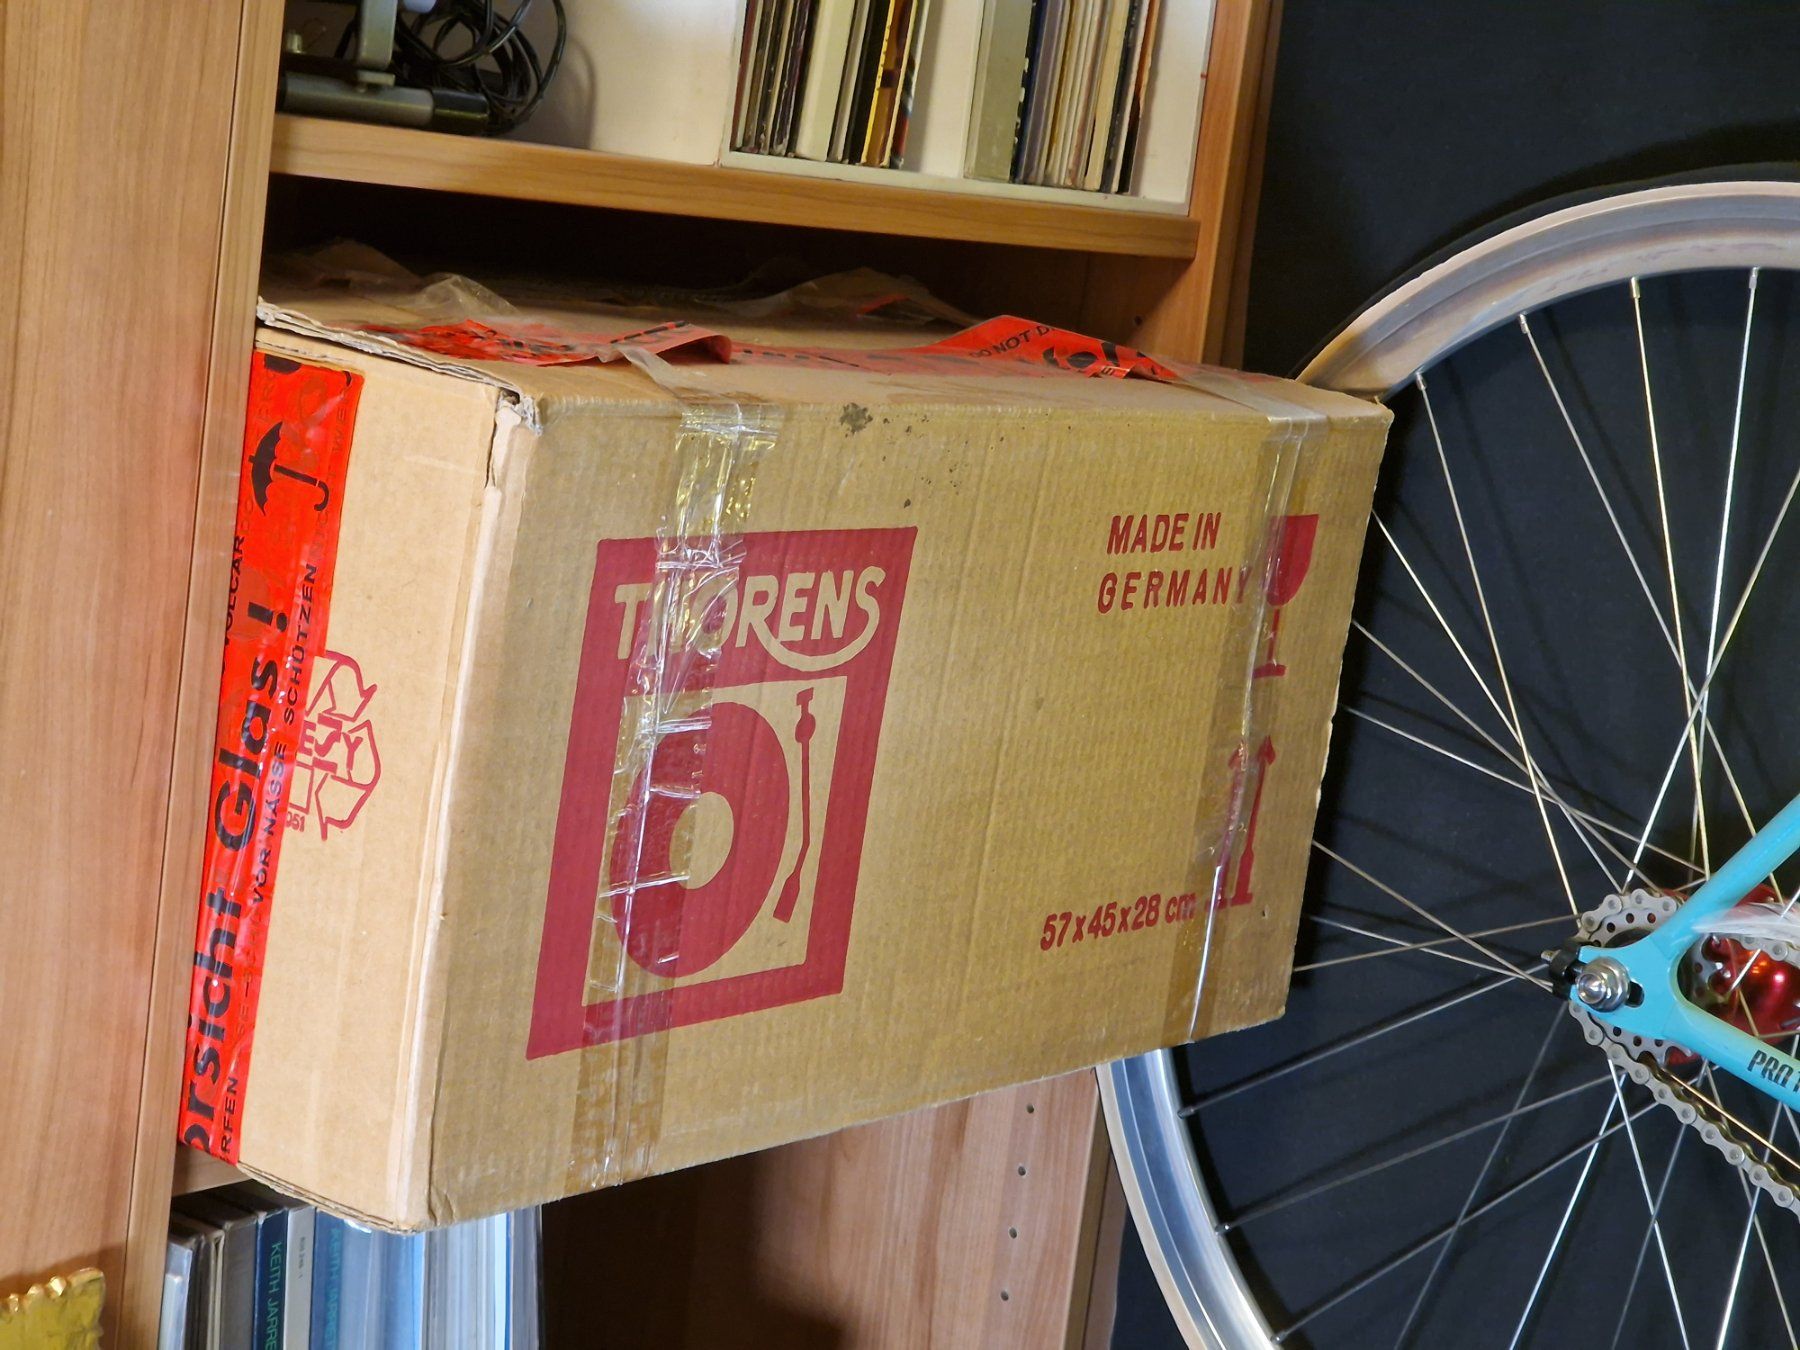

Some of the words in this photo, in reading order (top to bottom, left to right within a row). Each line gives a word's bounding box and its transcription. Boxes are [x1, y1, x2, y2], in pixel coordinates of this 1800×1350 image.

[992, 329, 1030, 354] NOT
[1106, 513, 1190, 555] MADE
[1192, 512, 1222, 551] IN
[1097, 566, 1253, 615] GERMANY
[614, 565, 887, 672] THORENS
[214, 654, 279, 852] Glas
[1165, 892, 1197, 925] cm
[219, 1076, 239, 1158] RFEN
[252, 848, 272, 905] VOR
[1747, 1049, 1794, 1088] PRO
[268, 1241, 283, 1294] KEITH
